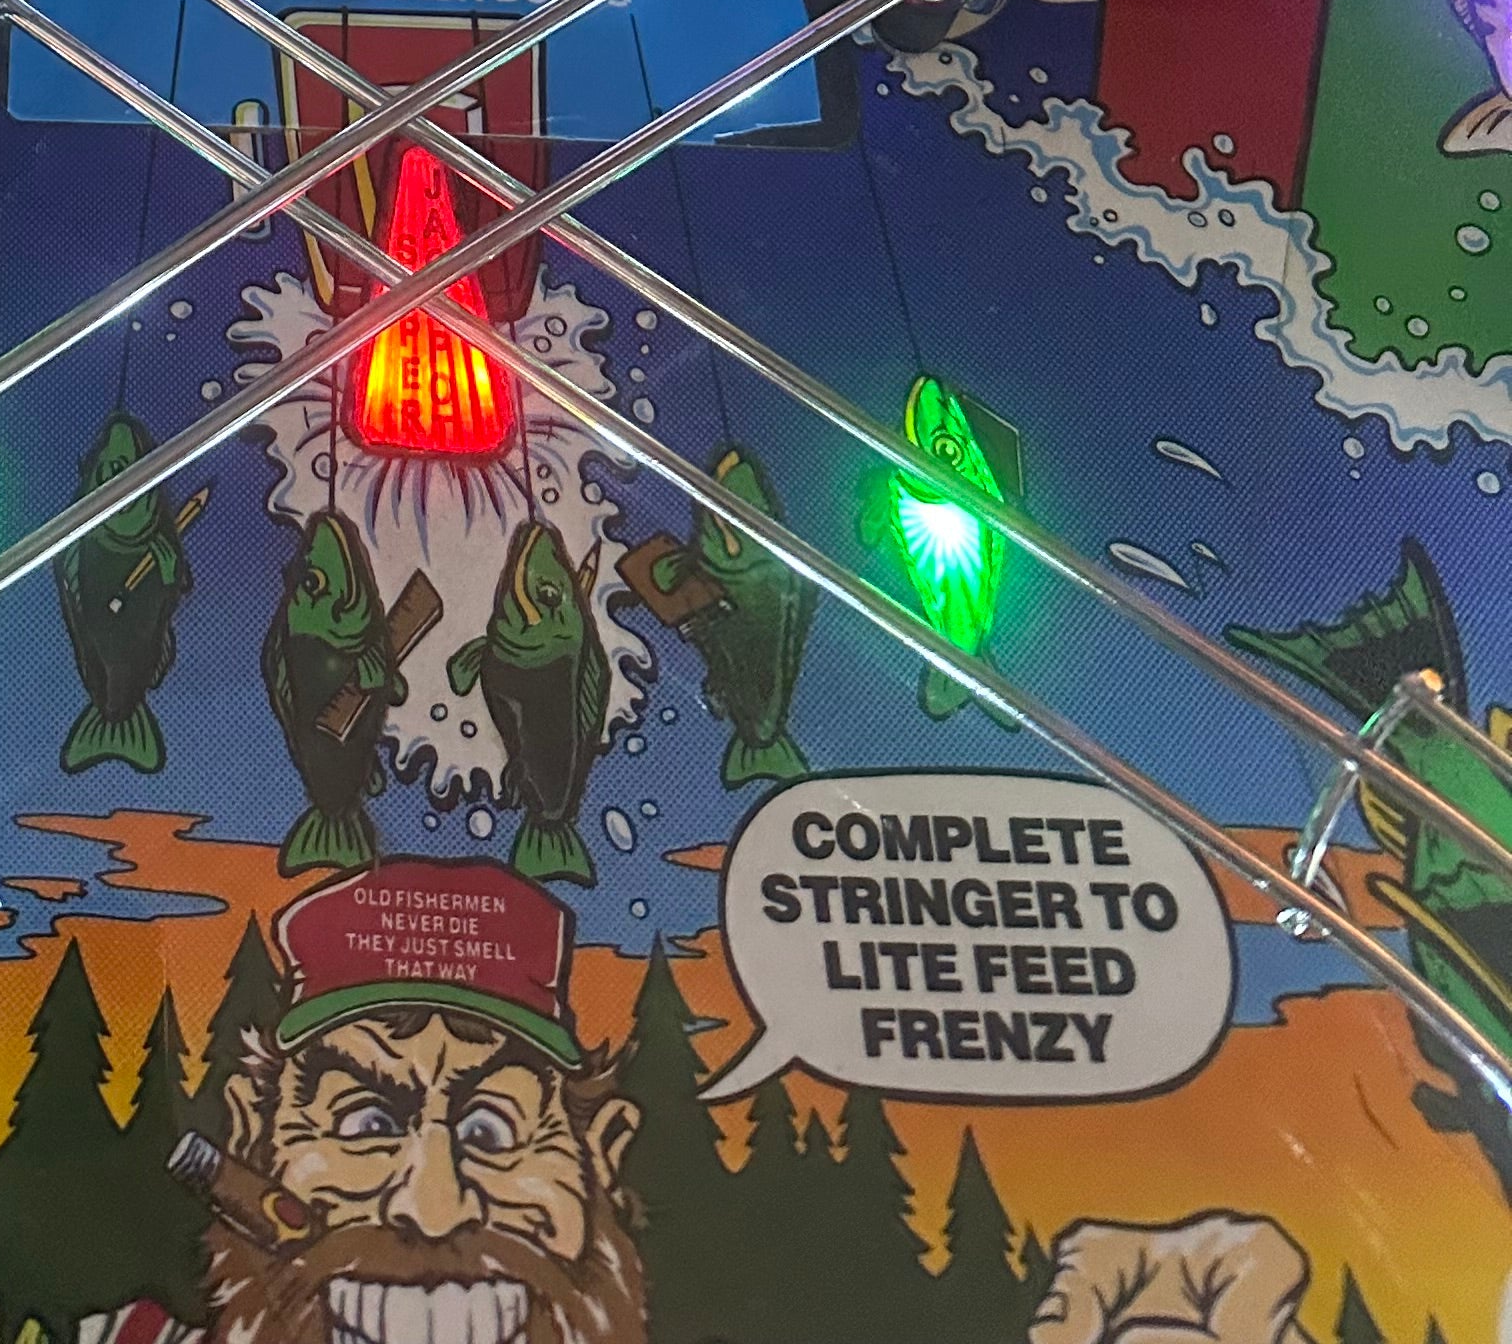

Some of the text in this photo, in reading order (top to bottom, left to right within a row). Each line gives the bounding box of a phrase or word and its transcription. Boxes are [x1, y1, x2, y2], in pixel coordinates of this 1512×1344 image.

[792, 810, 1130, 868] COMPLETE
[355, 887, 506, 914] OLD FISHERMEN
[762, 875, 1180, 933] STRINGER TO
[382, 913, 480, 936] NEVER DIE
[345, 932, 516, 962] THEY JUST SMELL
[385, 958, 479, 982] THAT WAY
[824, 941, 1137, 998] LITE FEED
[862, 1008, 1113, 1064] FRENZY
